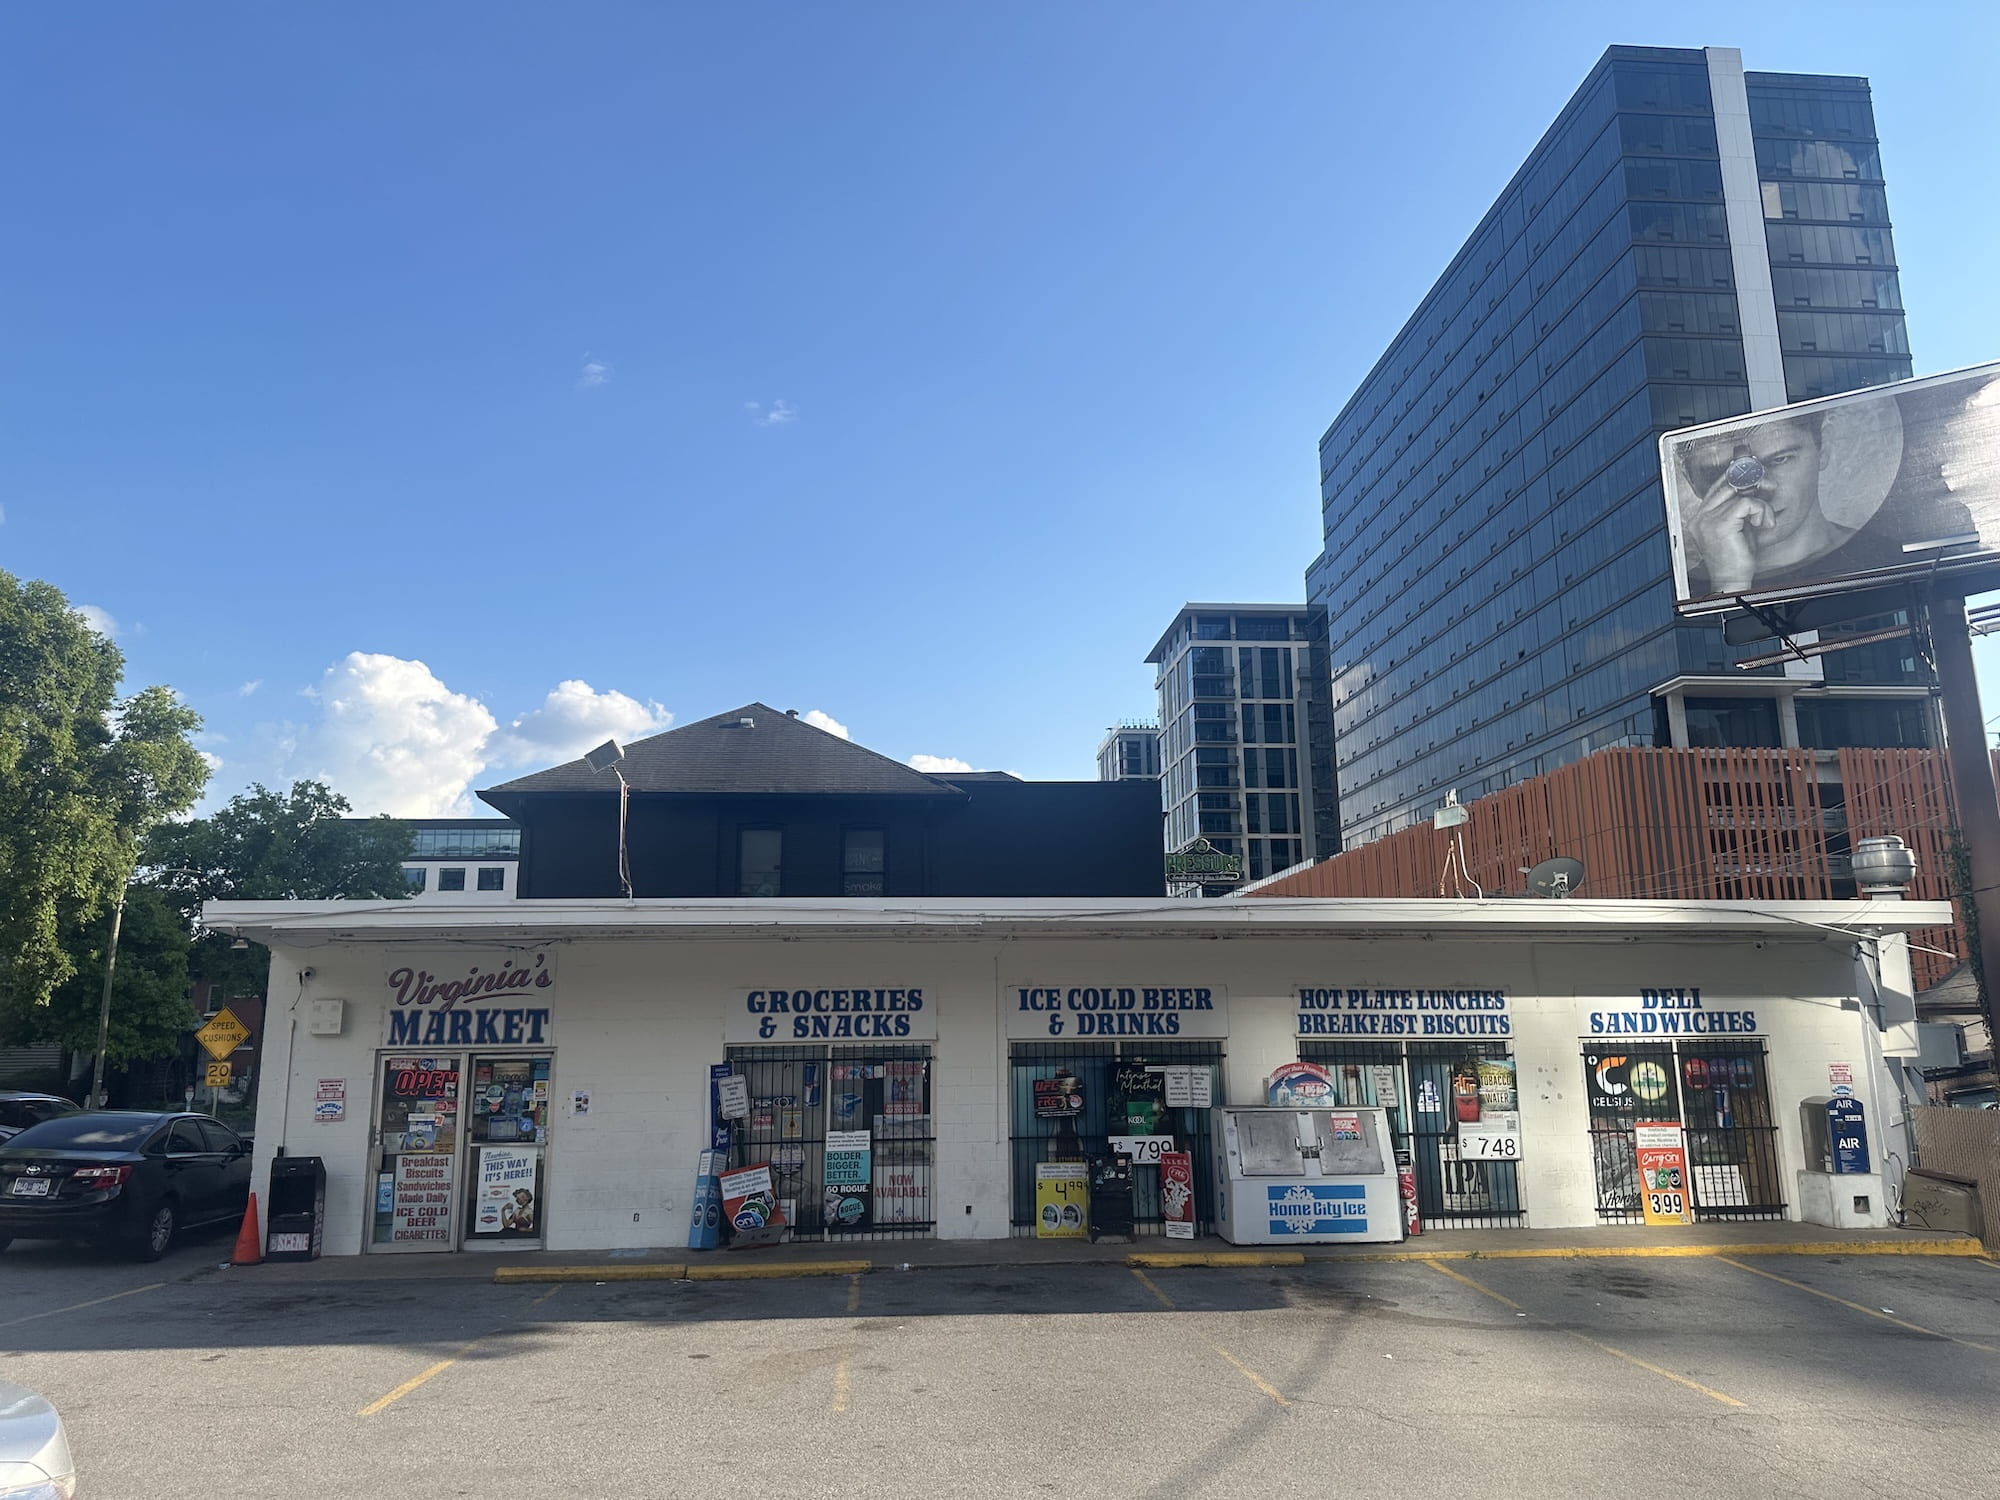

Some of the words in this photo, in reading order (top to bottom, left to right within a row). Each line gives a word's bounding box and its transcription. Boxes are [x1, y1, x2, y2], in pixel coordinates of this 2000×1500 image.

[388, 953, 553, 1014] Virginia's
[747, 988, 923, 1014] GROCERIES
[1018, 988, 1061, 1011] ICE
[1067, 988, 1136, 1010] COLD
[1141, 988, 1214, 1010] BEER
[1298, 988, 1343, 1009] HOT
[1346, 989, 1412, 1010] PLATE
[1416, 989, 1505, 1010] LUNCHES
[1639, 987, 1702, 1009] DELI
[211, 1021, 236, 1030] SPEED
[387, 1008, 549, 1046] MARKET
[758, 1016, 778, 1039] &
[793, 1014, 911, 1038] SNACKS
[1048, 1013, 1065, 1035] &
[1077, 1012, 1180, 1035] DRINKS
[1297, 1013, 1418, 1035] BREAKFAST
[1421, 1014, 1510, 1035] BISCUITS
[1590, 1011, 1757, 1033] SANDWICHES
[203, 1033, 242, 1043] CUSHIONS
[208, 1064, 230, 1077] 20
[1116, 1067, 1152, 1083] Intense
[394, 1070, 460, 1096] OPEN
[1120, 1079, 1163, 1094] Menthol
[1480, 1075, 1513, 1086] TOBACCO
[1484, 1092, 1509, 1103] WATER
[1836, 1100, 1853, 1109] AIR
[1462, 1138, 1467, 1148] $
[1478, 1138, 1516, 1157] 7.48
[1838, 1138, 1860, 1149] AIR
[401, 1157, 449, 1168] Breakfast
[826, 1152, 864, 1161] BOLDER.
[485, 1161, 504, 1172] THIS
[506, 1158, 528, 1169] WAY
[826, 1161, 862, 1170] BIGGER.
[405, 1168, 444, 1179] Biscuits
[485, 1171, 500, 1182] IT'S
[503, 1168, 532, 1180] HERE!!
[826, 1171, 861, 1179] BETTER.
[397, 1181, 451, 1191] Sandwiches
[889, 1174, 913, 1186] NOW
[1038, 1182, 1043, 1190] $
[826, 1185, 839, 1193] GO
[840, 1184, 869, 1193] ROGUE.
[875, 1186, 928, 1198] AVAILABLE
[398, 1193, 423, 1203] Made
[426, 1193, 448, 1204] Daily
[396, 1208, 415, 1217] ICE
[418, 1207, 448, 1216] COLD
[1269, 1202, 1311, 1216] Home
[1313, 1201, 1341, 1218] City
[1343, 1201, 1366, 1215] Ice
[407, 1217, 436, 1227] BEER
[395, 1229, 447, 1240] CIGARETTES
